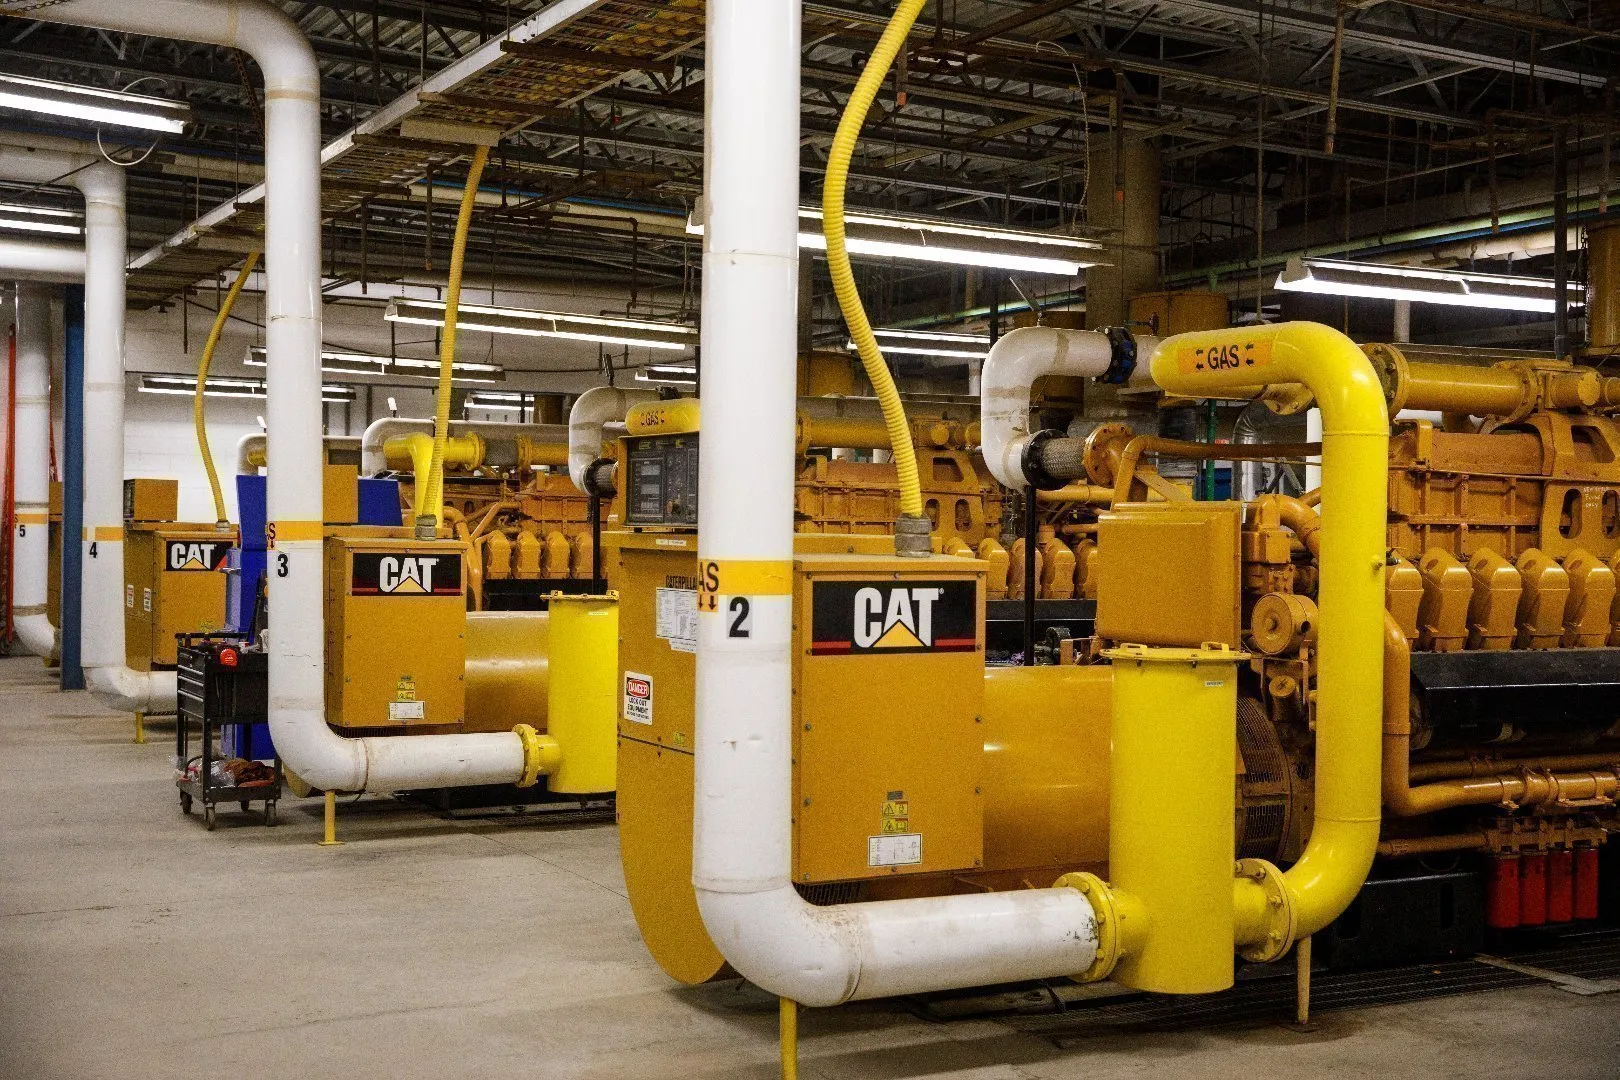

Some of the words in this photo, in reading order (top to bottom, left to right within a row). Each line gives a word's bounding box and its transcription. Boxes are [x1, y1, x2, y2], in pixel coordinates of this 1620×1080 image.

[1207, 344, 1240, 370] GAS
[645, 411, 660, 426] GAS
[19, 524, 26, 538] 5
[89, 541, 98, 559] 4
[171, 543, 215, 570] CAT
[277, 553, 289, 578] 3
[379, 556, 437, 593] CAT
[698, 562, 719, 593] AS
[665, 574, 698, 591] CATERPILLA
[728, 596, 750, 638] 2
[853, 587, 939, 648] CAT
[628, 681, 648, 695] DANGER
